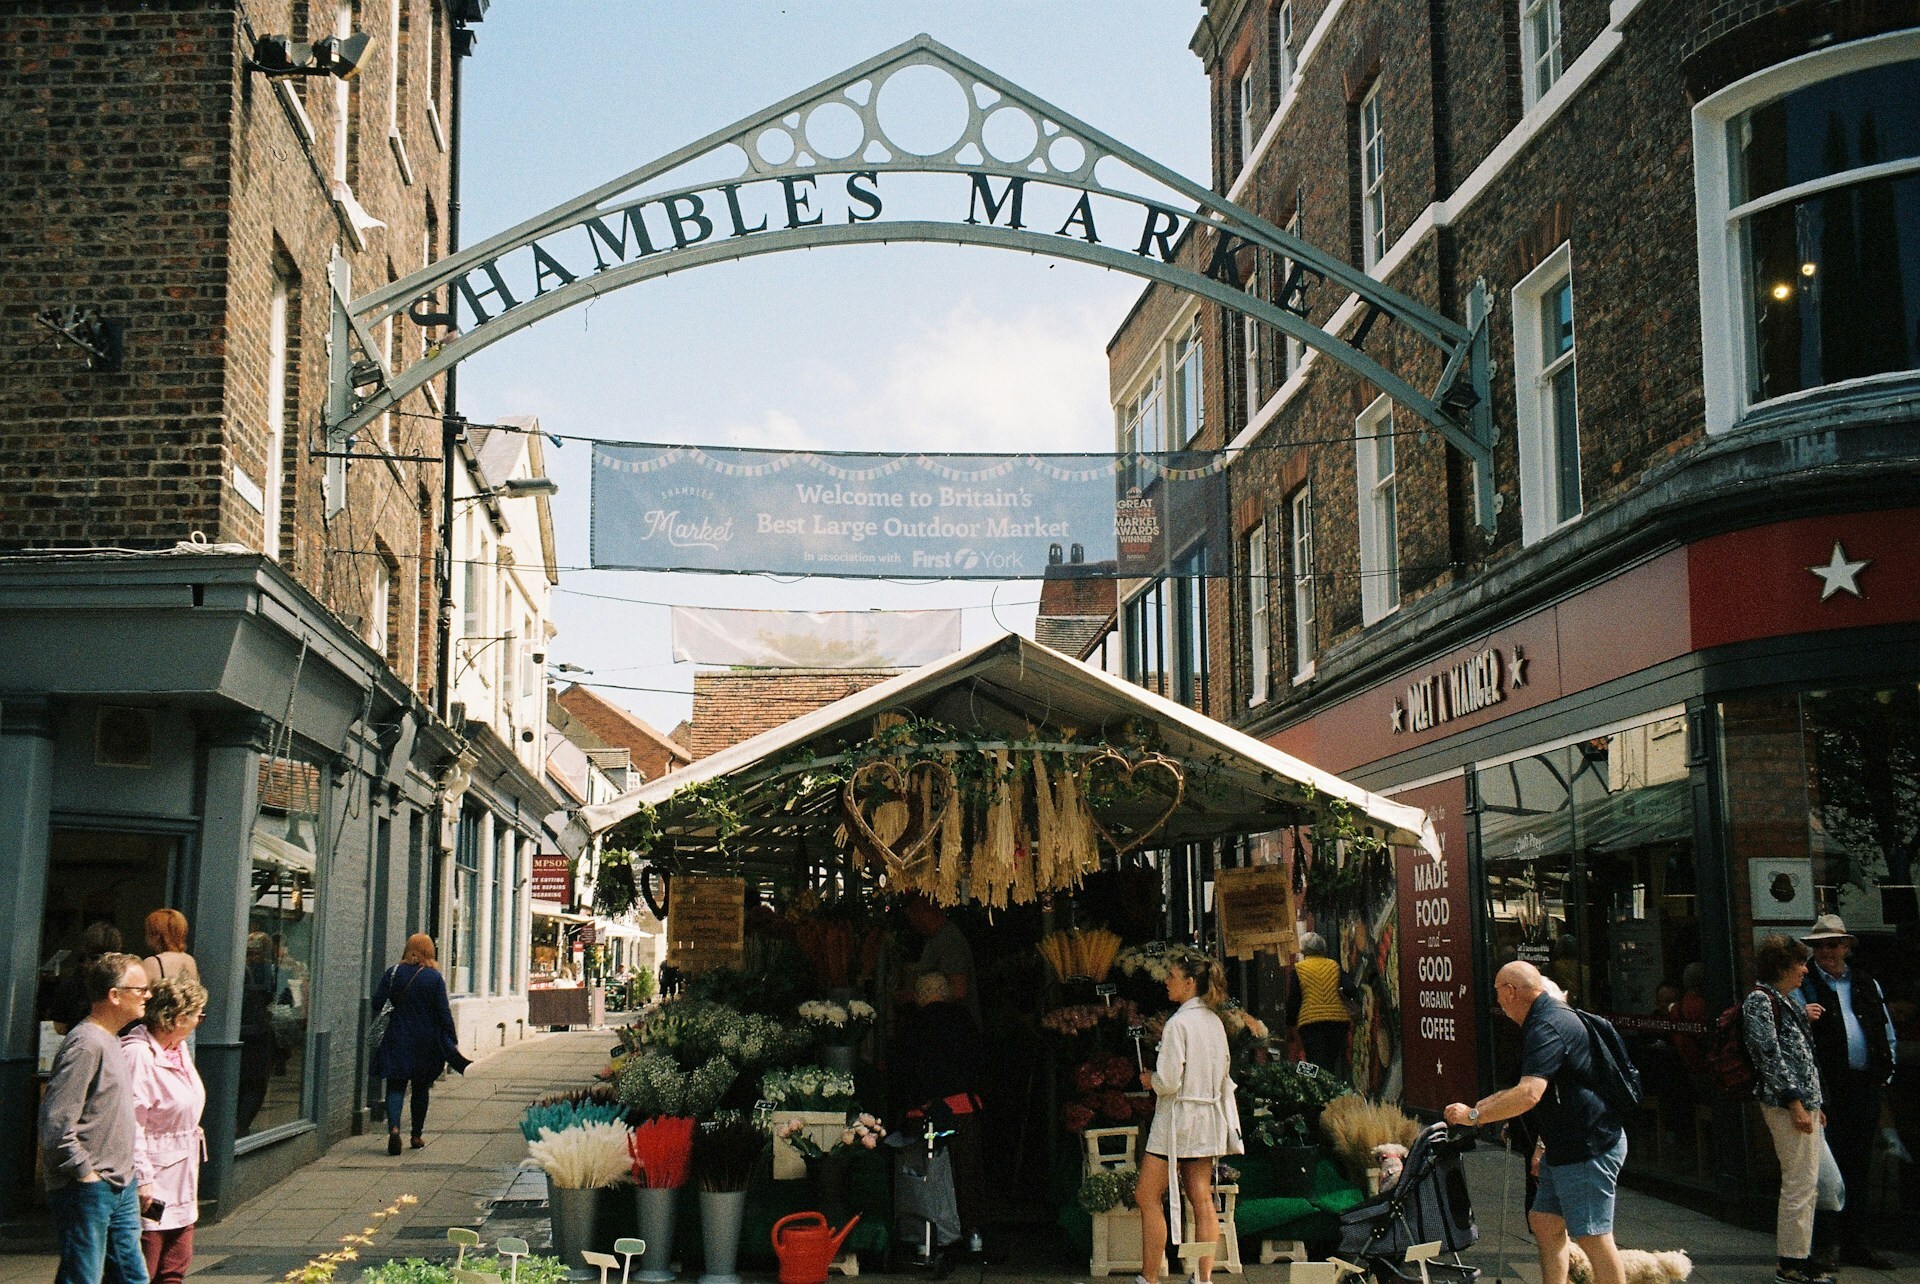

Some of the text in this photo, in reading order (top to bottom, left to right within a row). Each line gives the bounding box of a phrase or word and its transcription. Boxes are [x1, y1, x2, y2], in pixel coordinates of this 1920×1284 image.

[409, 171, 1396, 352] SHAMBLES MARKET
[661, 487, 715, 501] SHAMBLES
[796, 484, 1032, 508] Welcome to Britain's
[1117, 498, 1153, 509] GREAT
[640, 510, 734, 551] Market
[757, 513, 1069, 541] Best Large Outdoor Market
[1113, 526, 1160, 536] AWARDS
[1114, 516, 1157, 527] MARKET
[1119, 535, 1153, 543] WINNER
[804, 550, 1024, 568] in association with First York
[1407, 648, 1501, 732] PRET A MANGER
[1414, 860, 1449, 892] MADE
[1415, 897, 1450, 927] FOOD
[1418, 956, 1453, 982] GOOD
[1420, 990, 1454, 1009] ORGANIC
[1421, 1017, 1456, 1041] COFFEE
